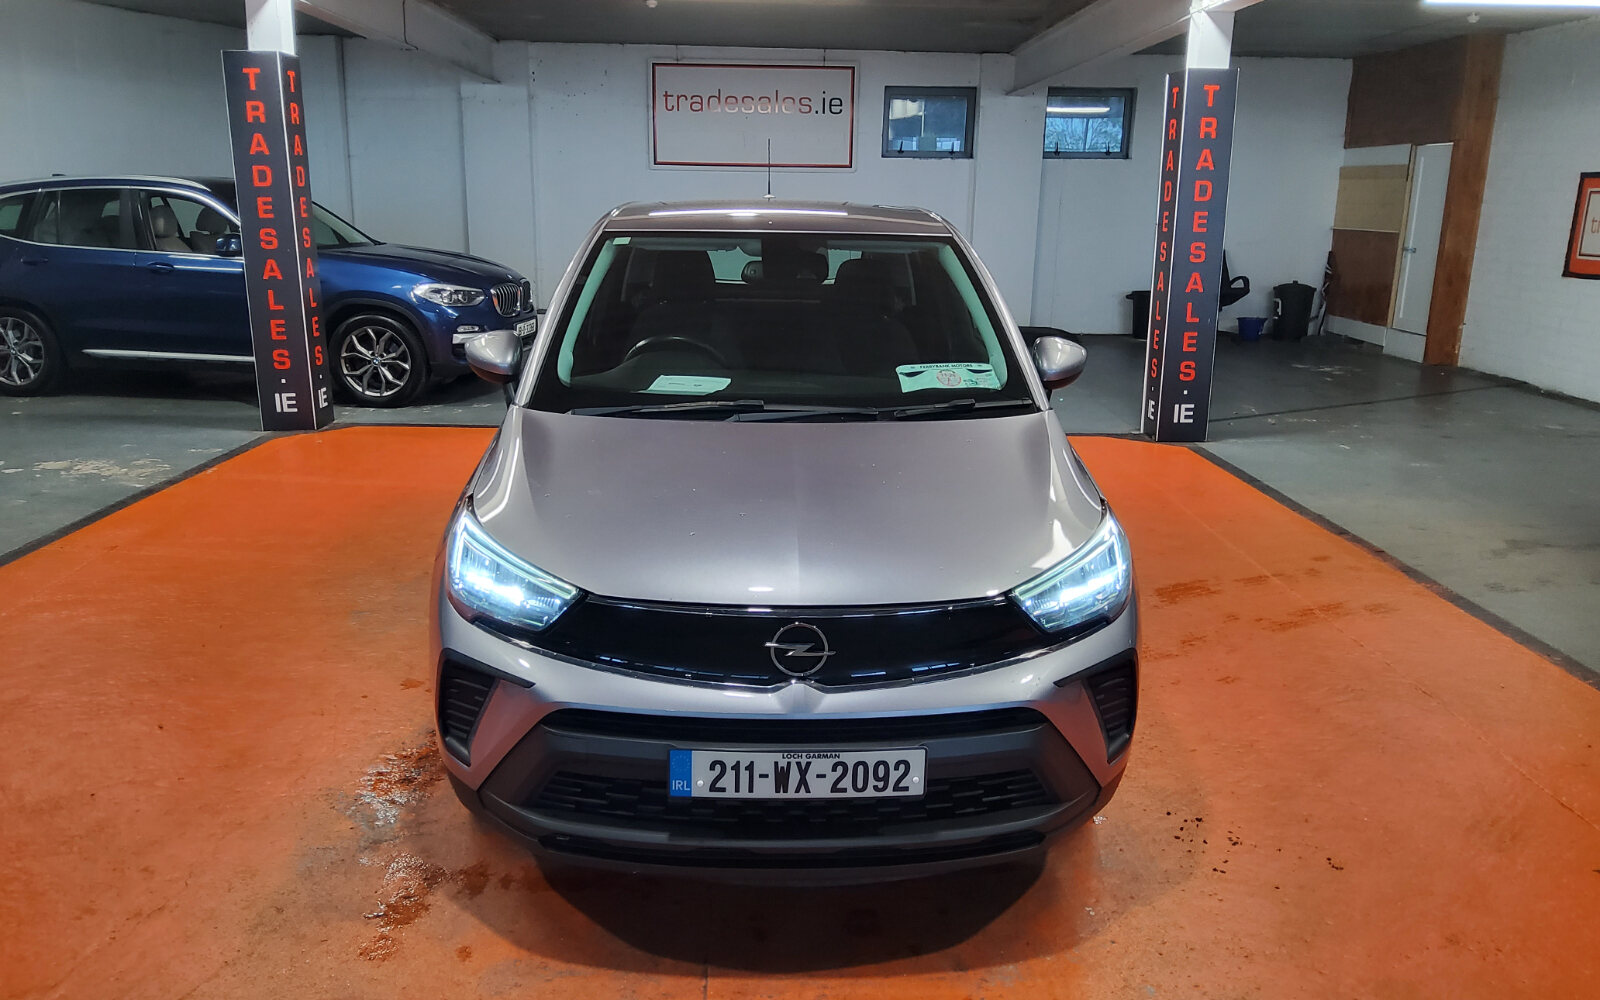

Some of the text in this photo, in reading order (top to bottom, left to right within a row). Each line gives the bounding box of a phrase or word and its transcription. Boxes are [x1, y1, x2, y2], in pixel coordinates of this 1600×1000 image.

[663, 88, 843, 115] tradesales.ie
[672, 779, 691, 791] IRL
[708, 759, 911, 794] 211-WX-2092
